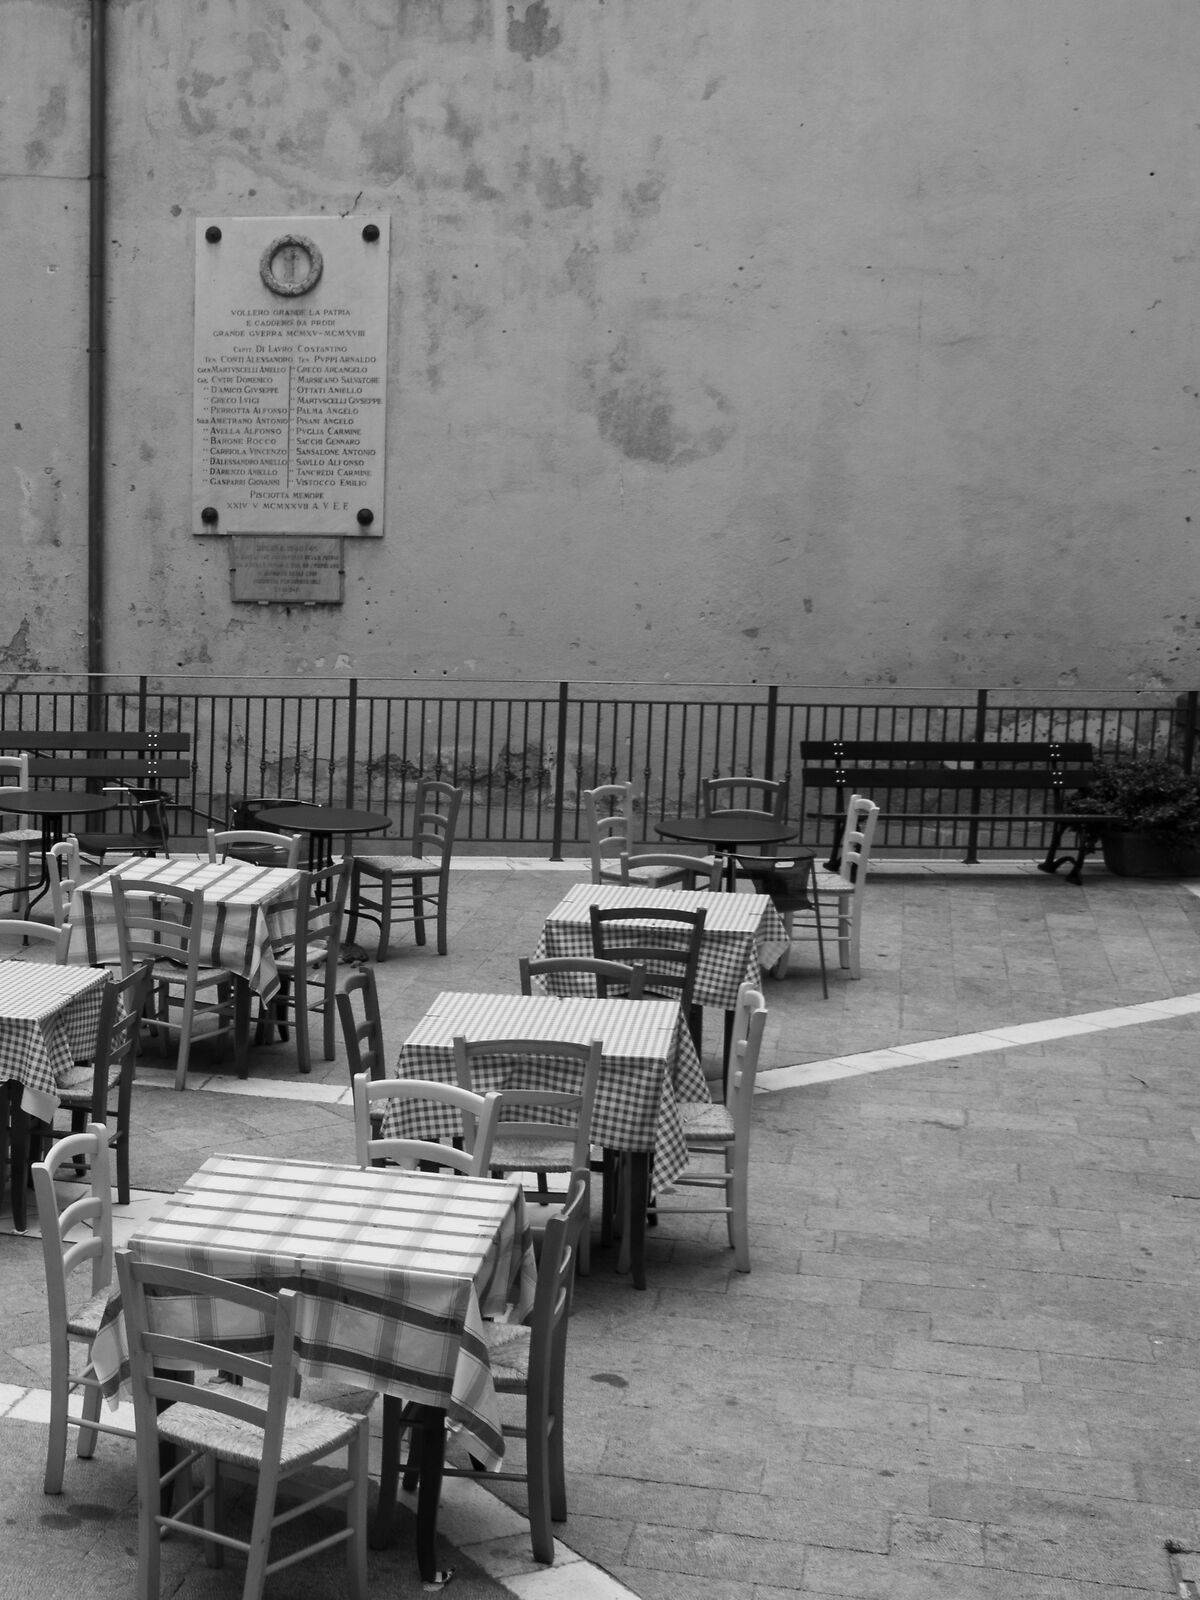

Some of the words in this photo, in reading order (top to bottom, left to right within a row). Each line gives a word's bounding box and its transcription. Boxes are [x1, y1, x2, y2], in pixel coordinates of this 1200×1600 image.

[247, 437, 276, 445] ROCCO
[340, 479, 367, 487] EMILIO
[250, 490, 289, 499] PISCIOTTA
